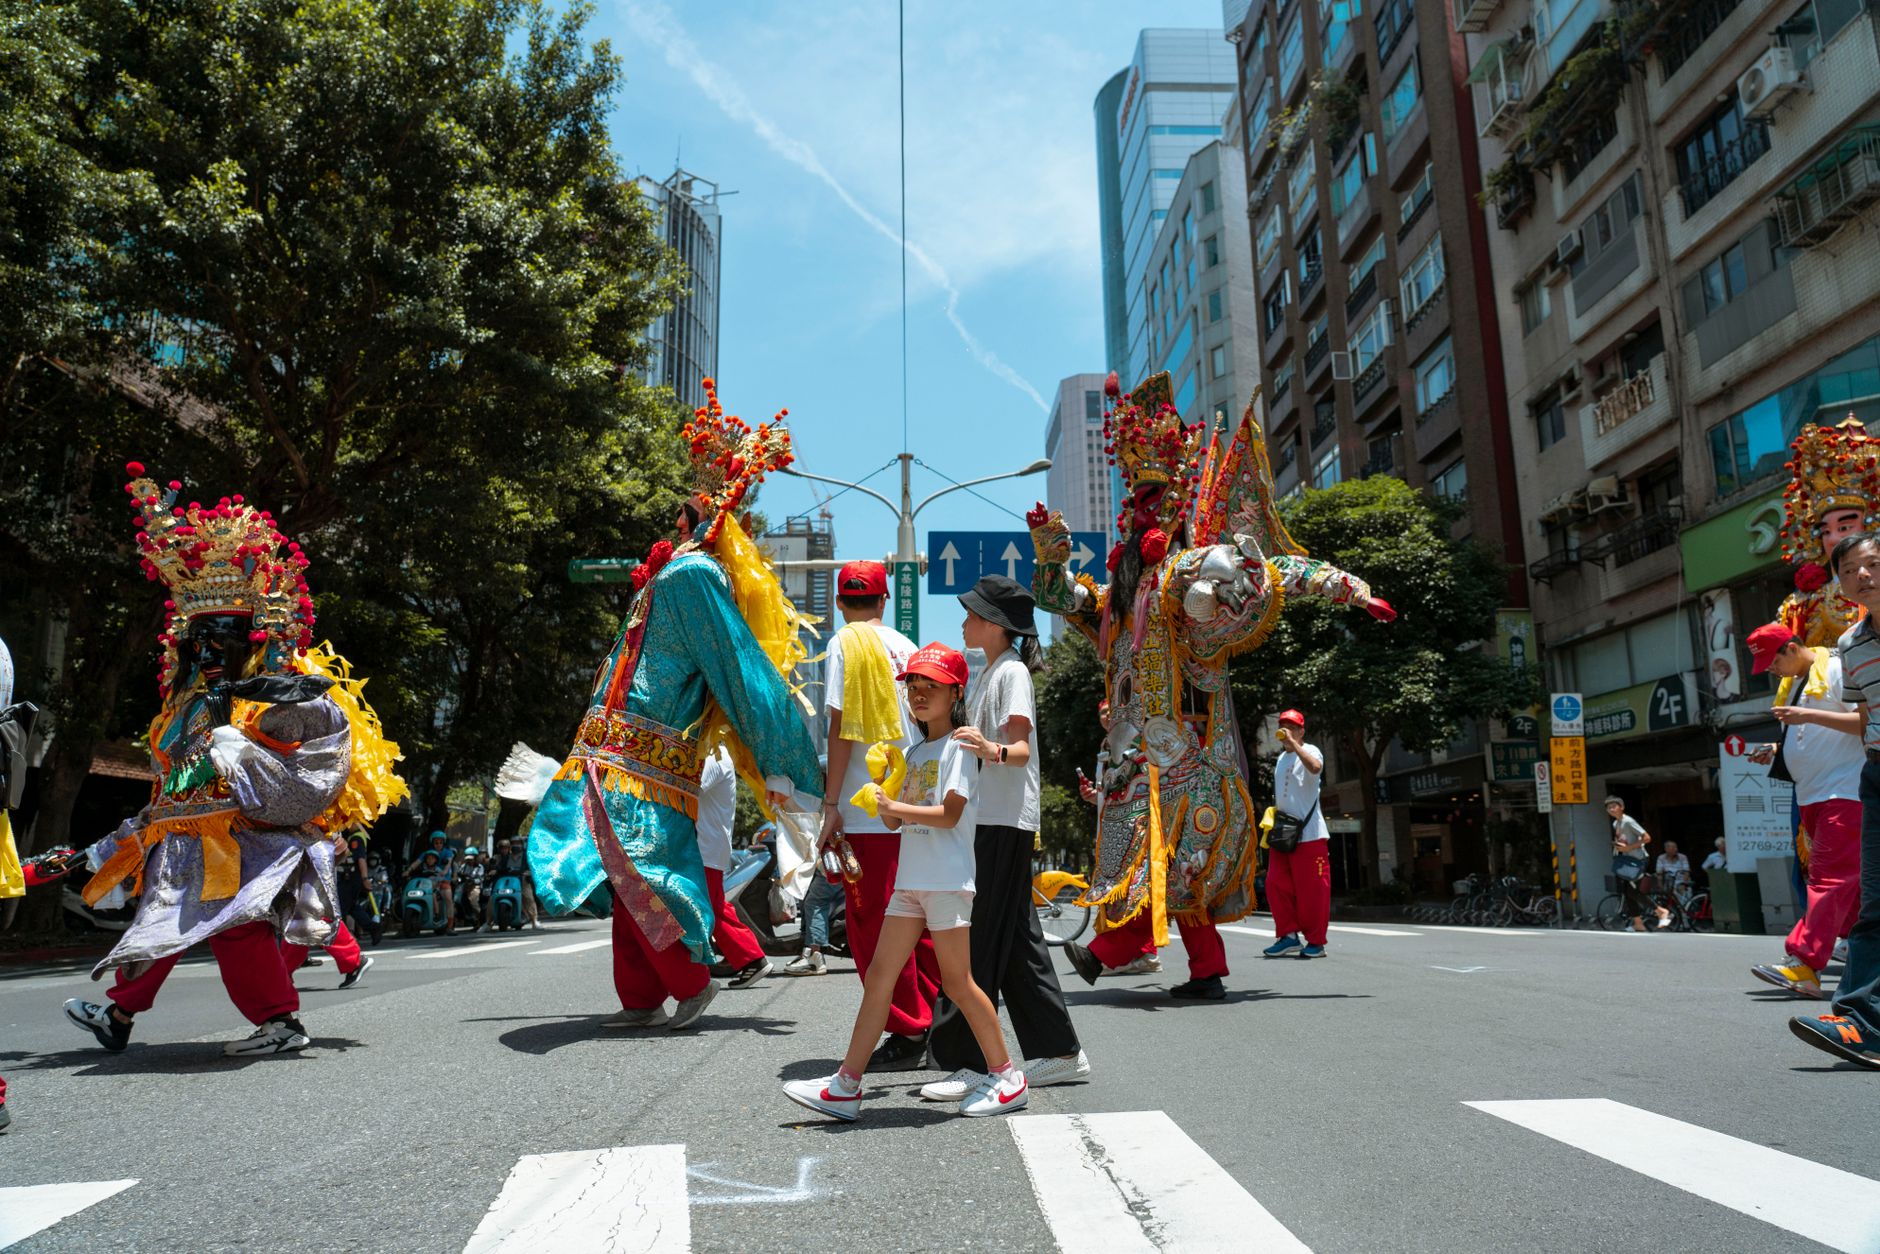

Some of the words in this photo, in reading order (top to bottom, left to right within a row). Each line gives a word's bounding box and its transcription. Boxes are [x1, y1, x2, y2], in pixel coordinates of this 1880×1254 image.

[901, 573, 912, 631] 基隆路二段
[1657, 687, 1682, 724] 2F
[1515, 718, 1532, 734] 2F
[1742, 840, 1794, 851] 2769-27
[1836, 1024, 1864, 1044] N
